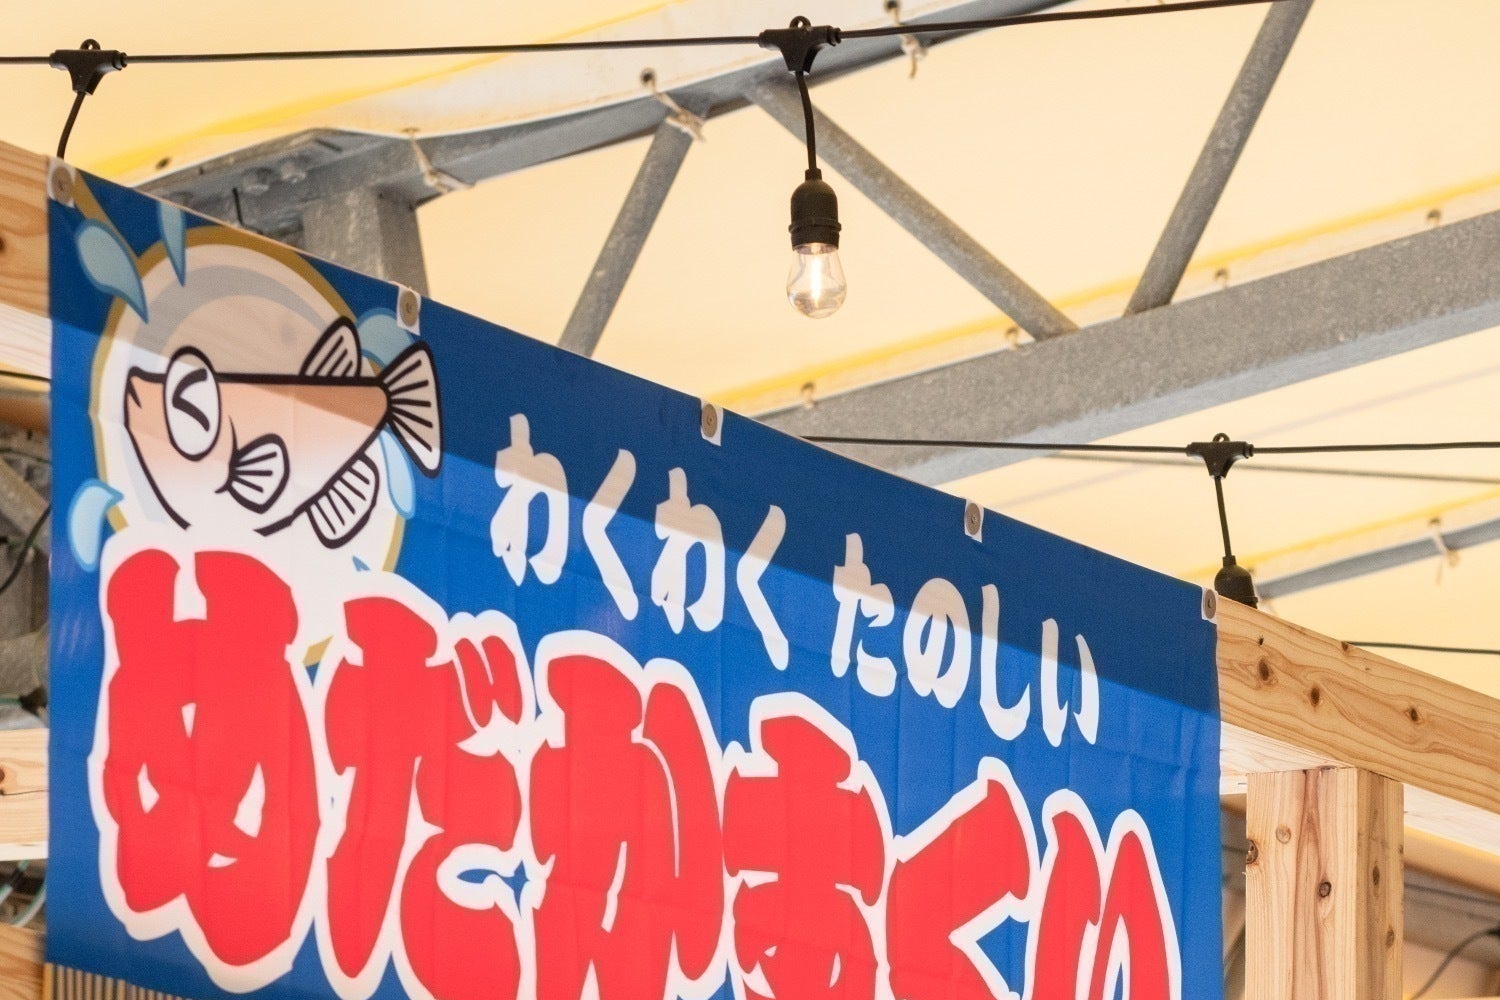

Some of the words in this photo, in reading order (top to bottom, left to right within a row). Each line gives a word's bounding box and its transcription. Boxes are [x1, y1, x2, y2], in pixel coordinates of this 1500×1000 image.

[489, 412, 788, 671] わくわく
[831, 532, 1099, 747] たのしい
